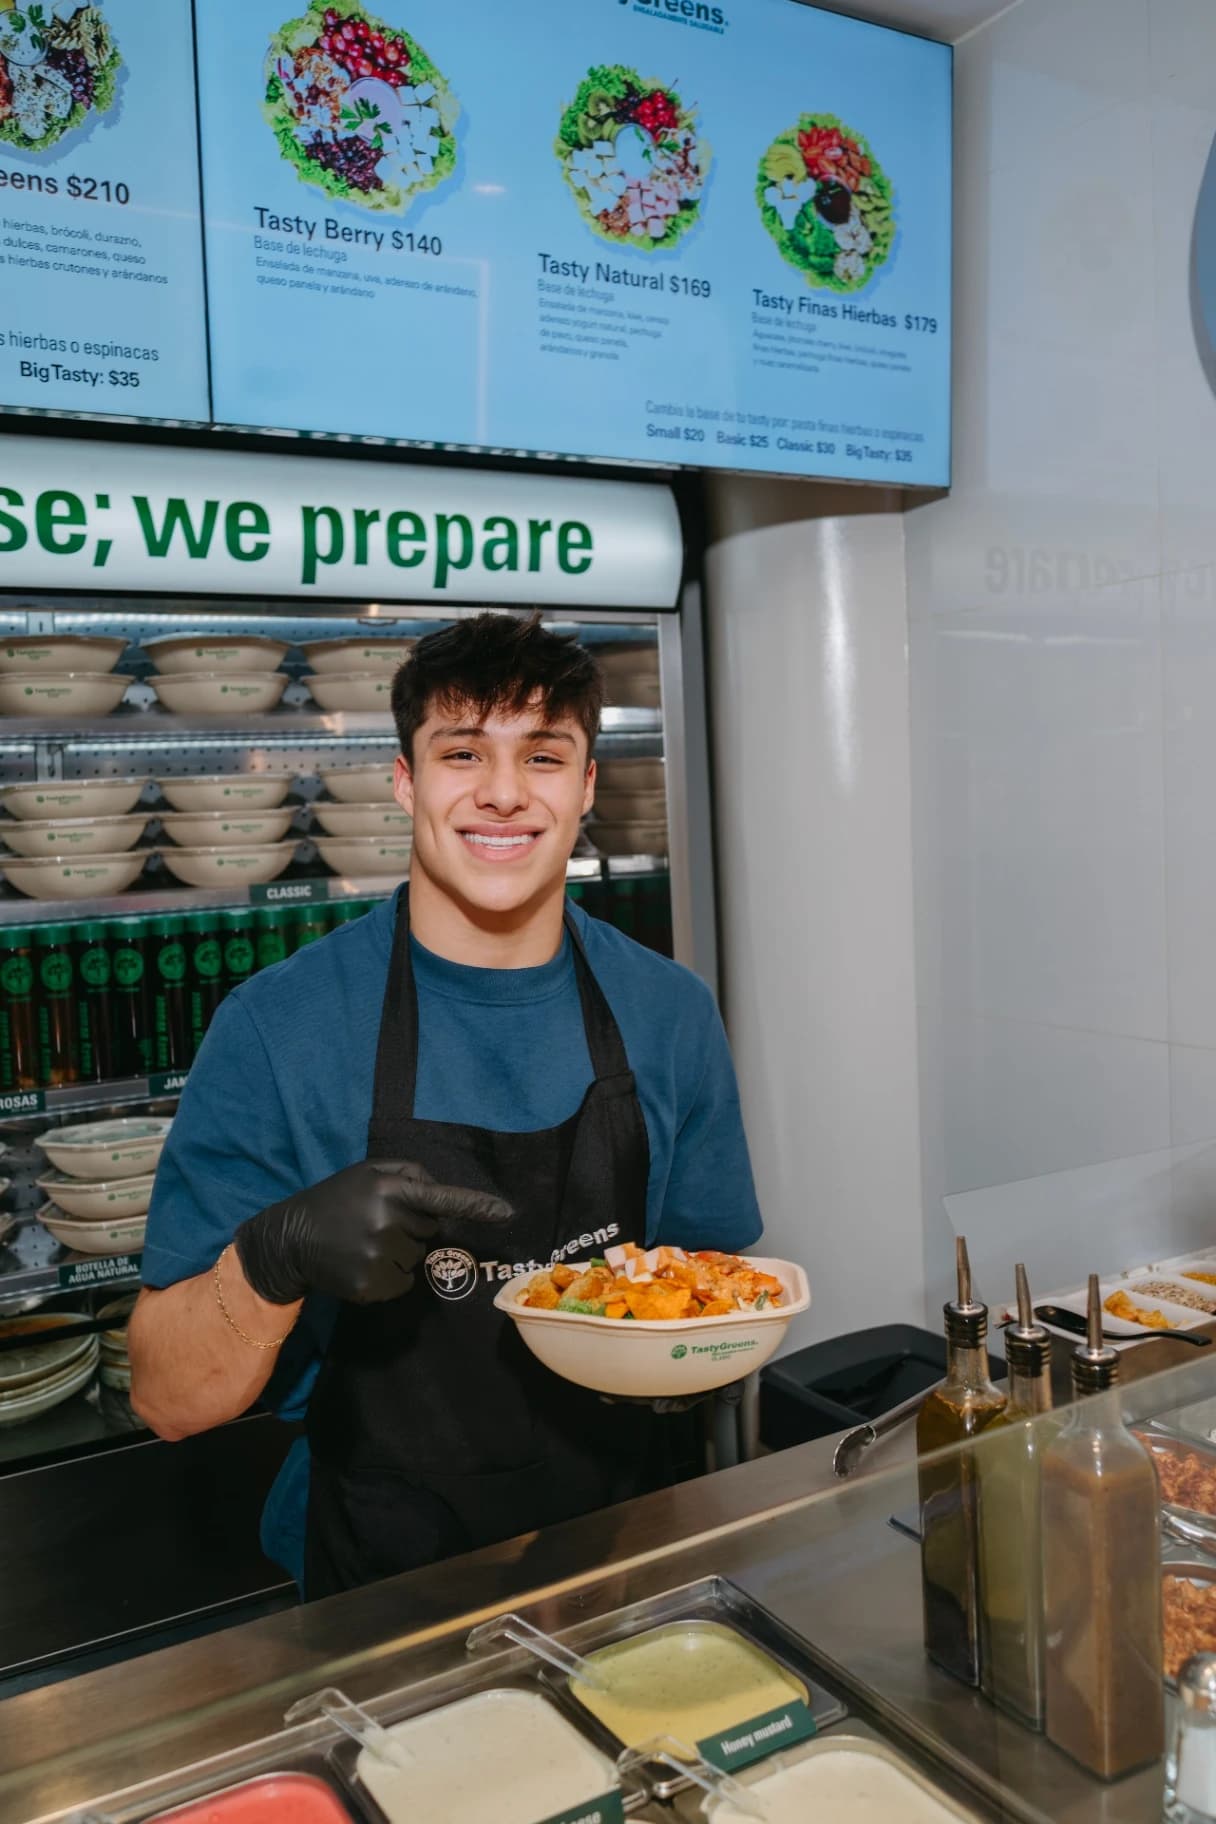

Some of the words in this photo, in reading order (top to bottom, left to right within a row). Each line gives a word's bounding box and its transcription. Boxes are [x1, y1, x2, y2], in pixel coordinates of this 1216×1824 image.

[66, 173, 129, 204] $210
[254, 206, 316, 240] Tasty
[325, 218, 384, 251] Berry
[392, 230, 442, 256] $140
[8, 253, 50, 269] hierbas
[112, 252, 146, 265] queso
[254, 235, 283, 252] Base
[286, 240, 300, 254] de
[303, 242, 347, 264] lechuga
[538, 253, 589, 283] Tasty
[596, 262, 664, 291] Natural
[670, 275, 711, 298] $169
[752, 288, 794, 314] Tasty
[798, 296, 838, 319] Finas
[842, 303, 897, 328] Hierbas
[904, 314, 938, 334] $179
[8, 330, 67, 352] hierbas
[70, 340, 80, 353] o
[83, 340, 160, 361] espinacas
[108, 370, 140, 388] $35
[646, 423, 681, 440] Small
[683, 427, 705, 442] $20
[716, 430, 746, 447] Basic
[750, 433, 769, 448] $25
[777, 437, 814, 453] Classic
[132, 495, 270, 562] we
[301, 505, 593, 589] prepare
[266, 886, 312, 900] CLASSIC
[68, 1272, 95, 1284] AGUA
[97, 1264, 139, 1279] NATURAL
[75, 1259, 115, 1273] BOTELLA
[117, 1256, 129, 1266] DE
[720, 1734, 755, 1756] Honey
[753, 1714, 793, 1742] mustard
